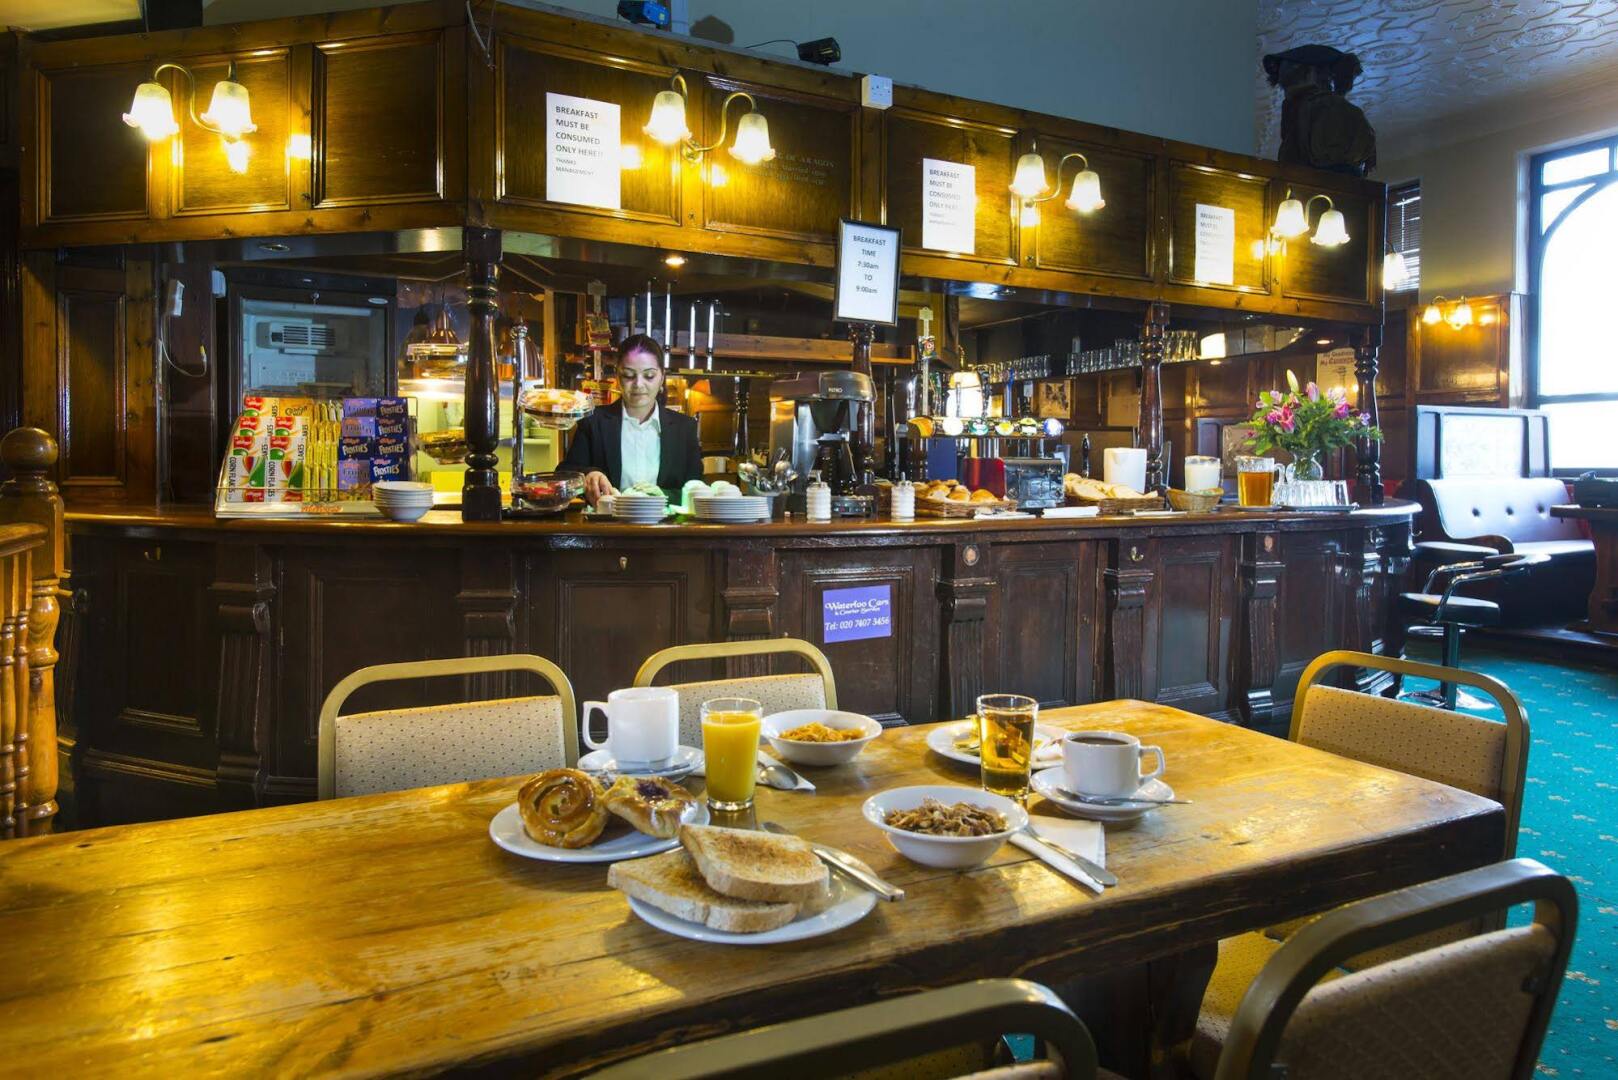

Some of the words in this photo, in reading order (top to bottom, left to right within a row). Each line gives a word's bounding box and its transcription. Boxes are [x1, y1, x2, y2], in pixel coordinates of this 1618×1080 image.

[555, 106, 598, 119] BREAKFAST
[555, 119, 578, 129] MUST
[580, 122, 589, 131] BE
[555, 132, 600, 145] CONSUMED
[555, 144, 577, 154] ONLY
[929, 169, 960, 179] BREAKFAST
[853, 235, 886, 246] BREAKFAST
[861, 248, 877, 257] TIME
[857, 260, 879, 270] 7:30am
[855, 284, 878, 294] 9:00am
[342, 443, 368, 456] FROSTIES
[268, 461, 276, 477] CORN
[373, 464, 400, 477] FROSTIES
[824, 600, 867, 611] Waterloo
[868, 598, 889, 608] Cars
[825, 622, 839, 631] Tel:
[839, 619, 854, 630] 020
[871, 616, 890, 626] 3456
